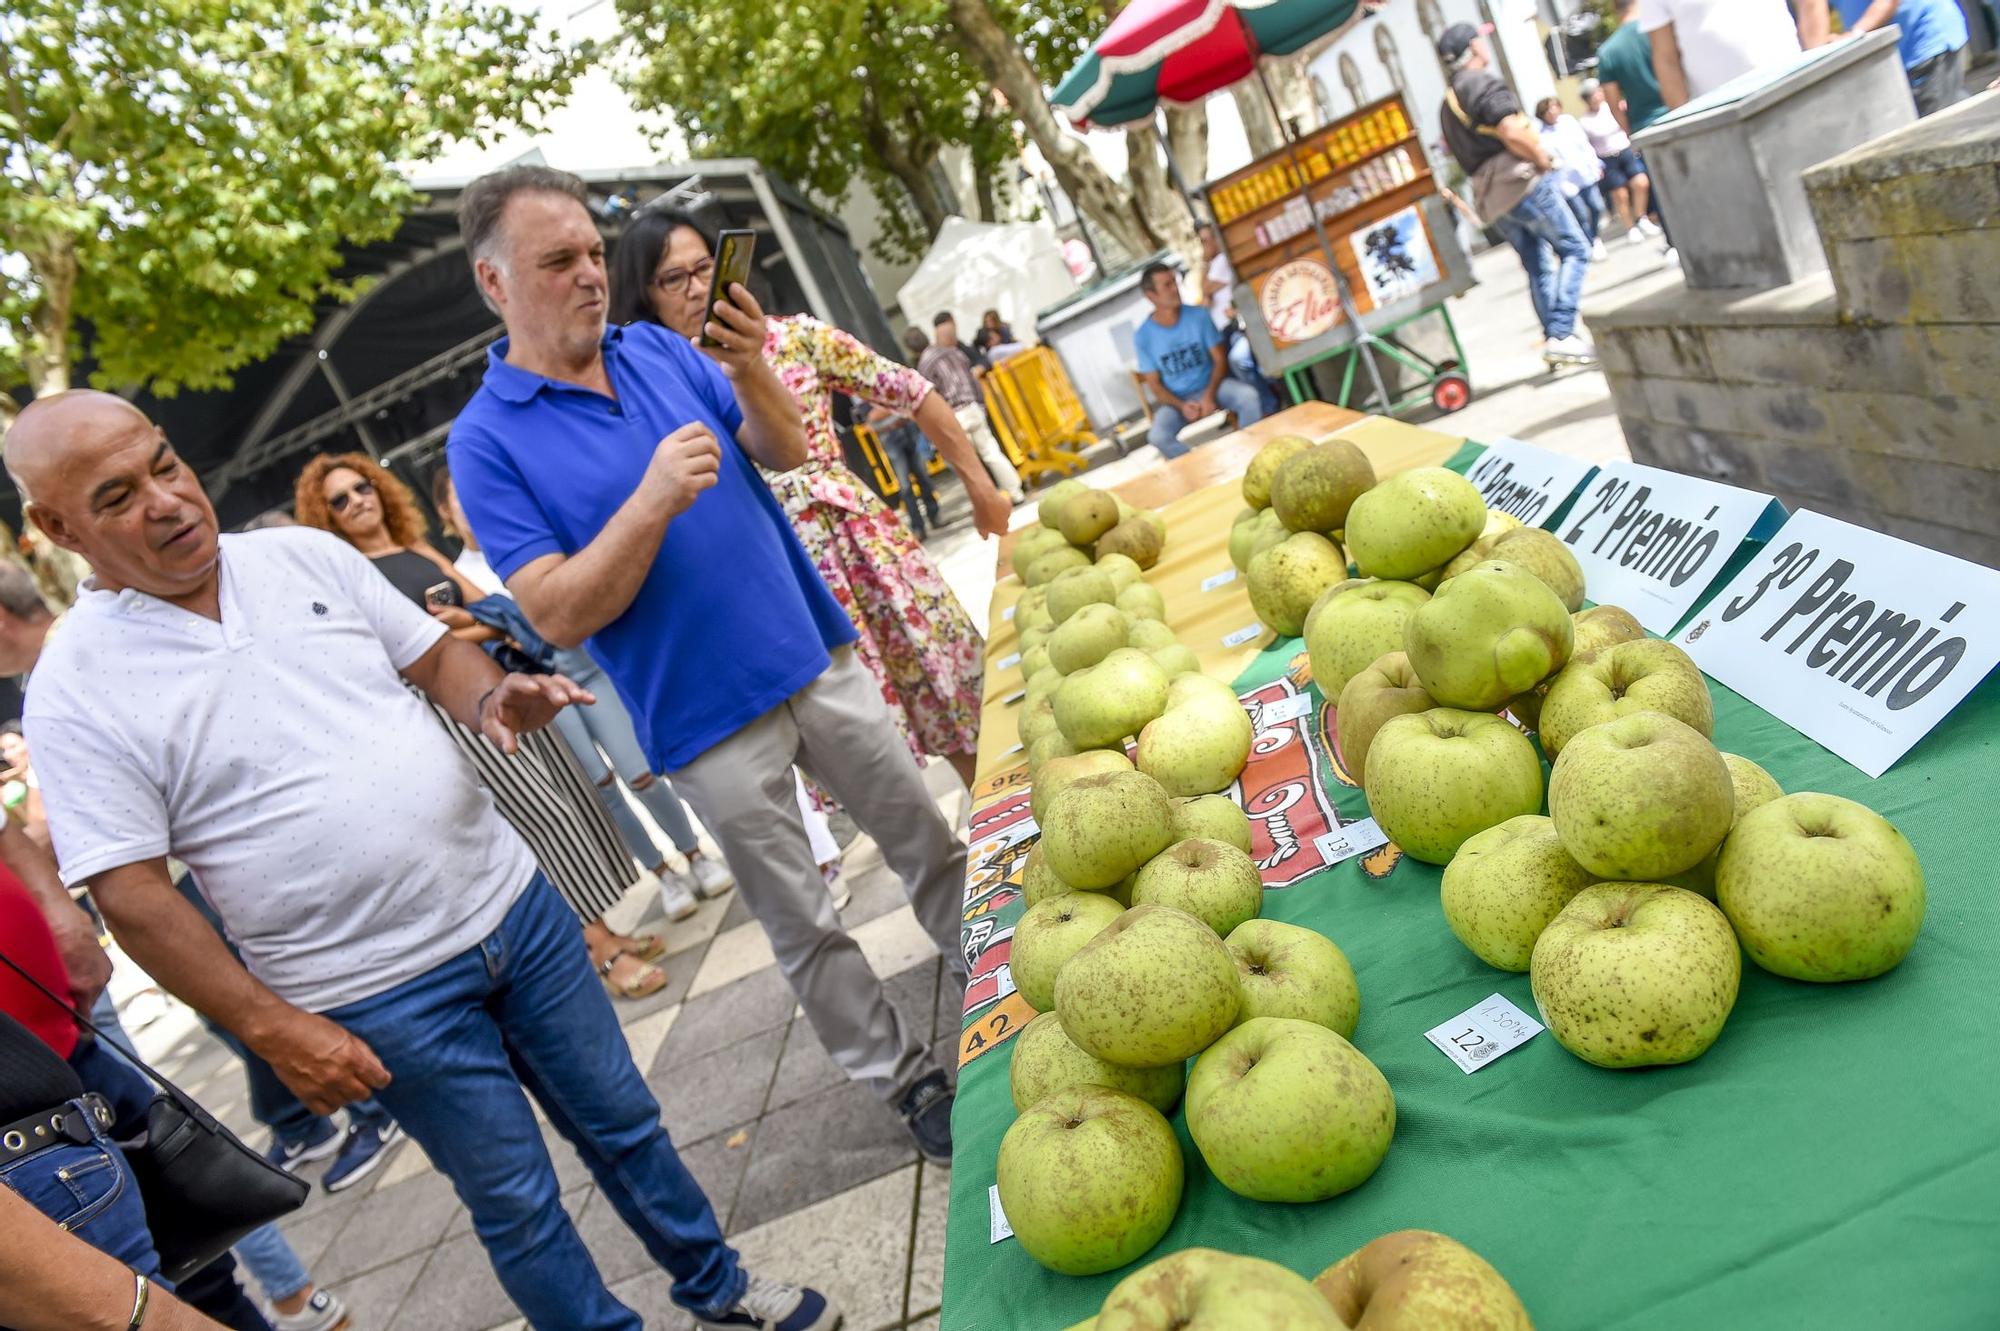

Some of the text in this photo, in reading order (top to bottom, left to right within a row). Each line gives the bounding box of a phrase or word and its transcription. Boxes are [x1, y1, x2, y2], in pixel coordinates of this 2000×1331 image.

[1592, 485, 1720, 588] Premio
[1760, 558, 1967, 711] Premio
[1328, 836, 1349, 852] 13
[966, 1013, 1014, 1053] 42
[1450, 1028, 1485, 1052] 12
